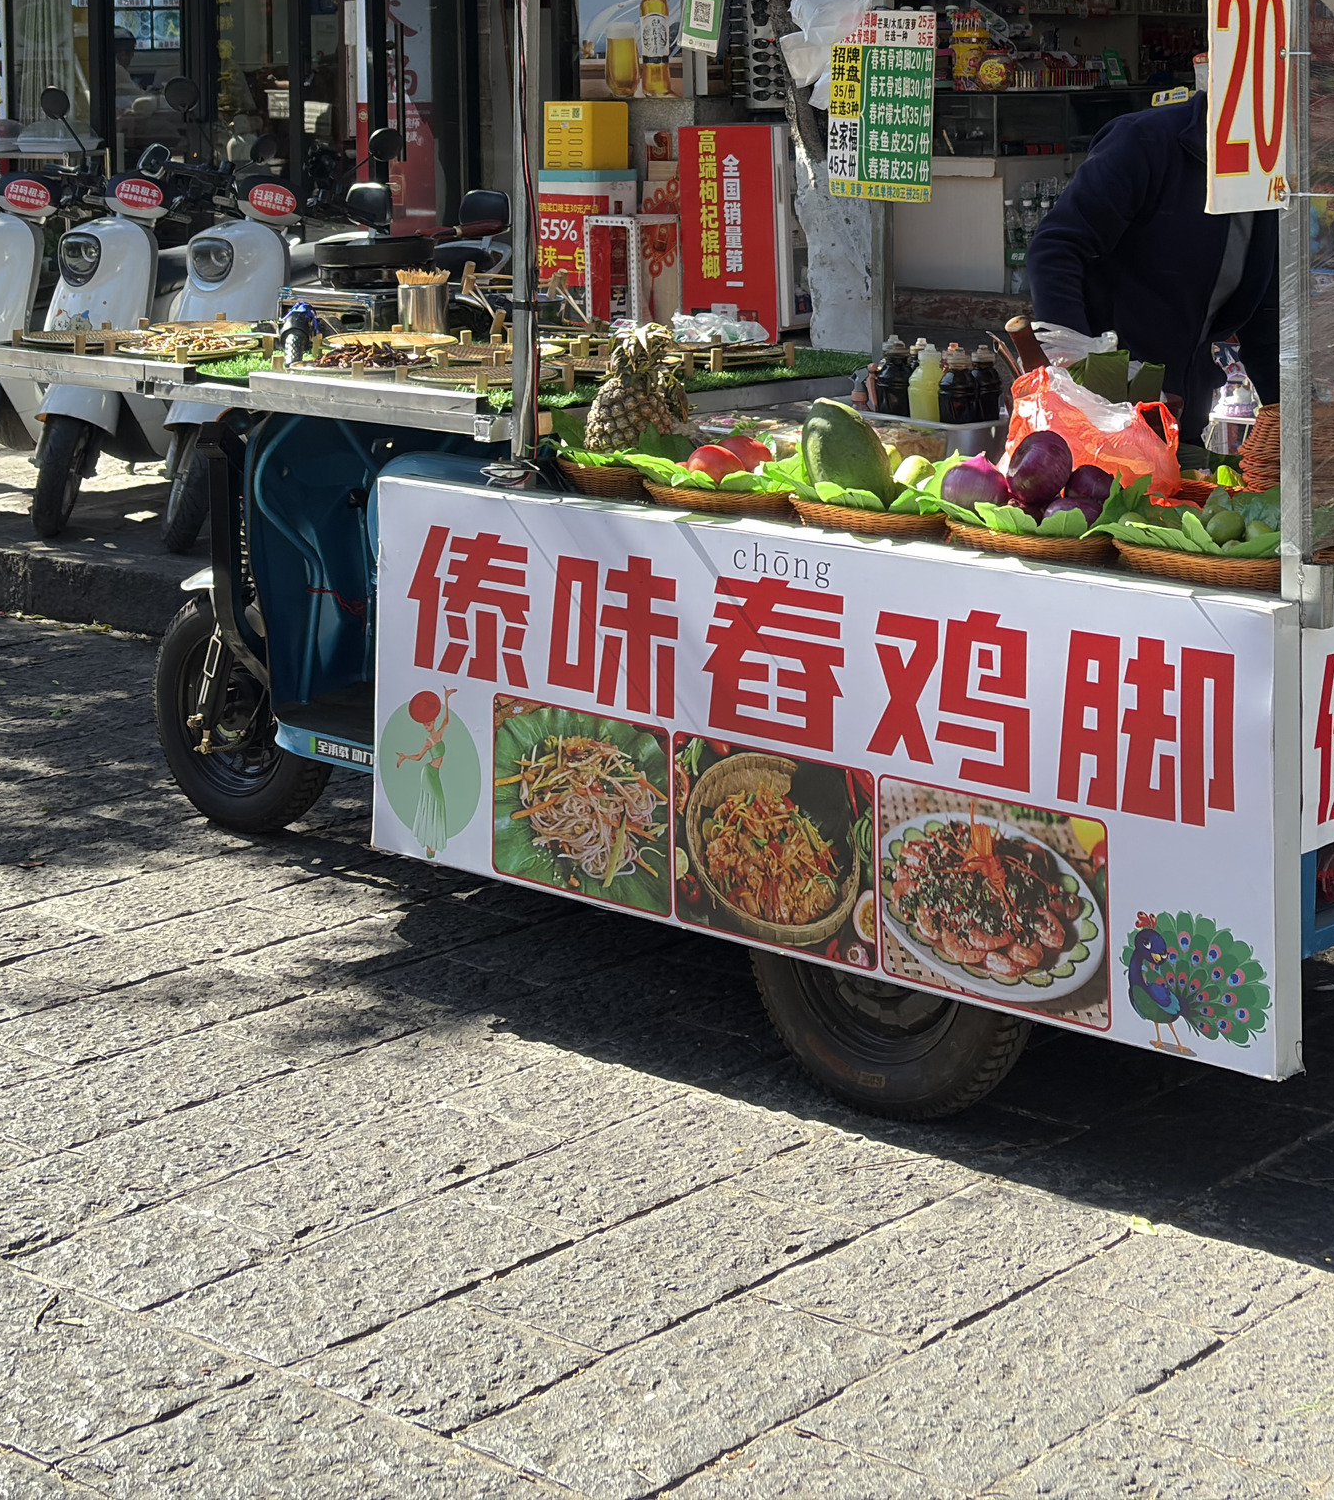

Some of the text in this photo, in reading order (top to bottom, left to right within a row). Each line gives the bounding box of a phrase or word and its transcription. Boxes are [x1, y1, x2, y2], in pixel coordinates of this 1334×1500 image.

[918, 15, 934, 29] 25元
[885, 31, 908, 42] 任选一种
[918, 32, 934, 46] 35元
[832, 47, 860, 64] 招牌
[832, 64, 860, 83] 拼盘
[834, 85, 855, 99] 35/份
[830, 100, 859, 117] 任选3种
[830, 122, 858, 152] 全家福
[829, 154, 856, 177] 45大份
[10, 183, 47, 199] 扫码租车
[120, 182, 160, 200] 扫码租车
[253, 188, 293, 208] 扫码租车
[539, 203, 599, 214] 购买口味王30元产品
[698, 130, 720, 279] 高端枸杞槟榔
[540, 219, 578, 241] 55%
[722, 154, 744, 288] 全国销量第一
[732, 546, 832, 589] chōng
[407, 522, 1237, 828] 傣味舂鸡脚
